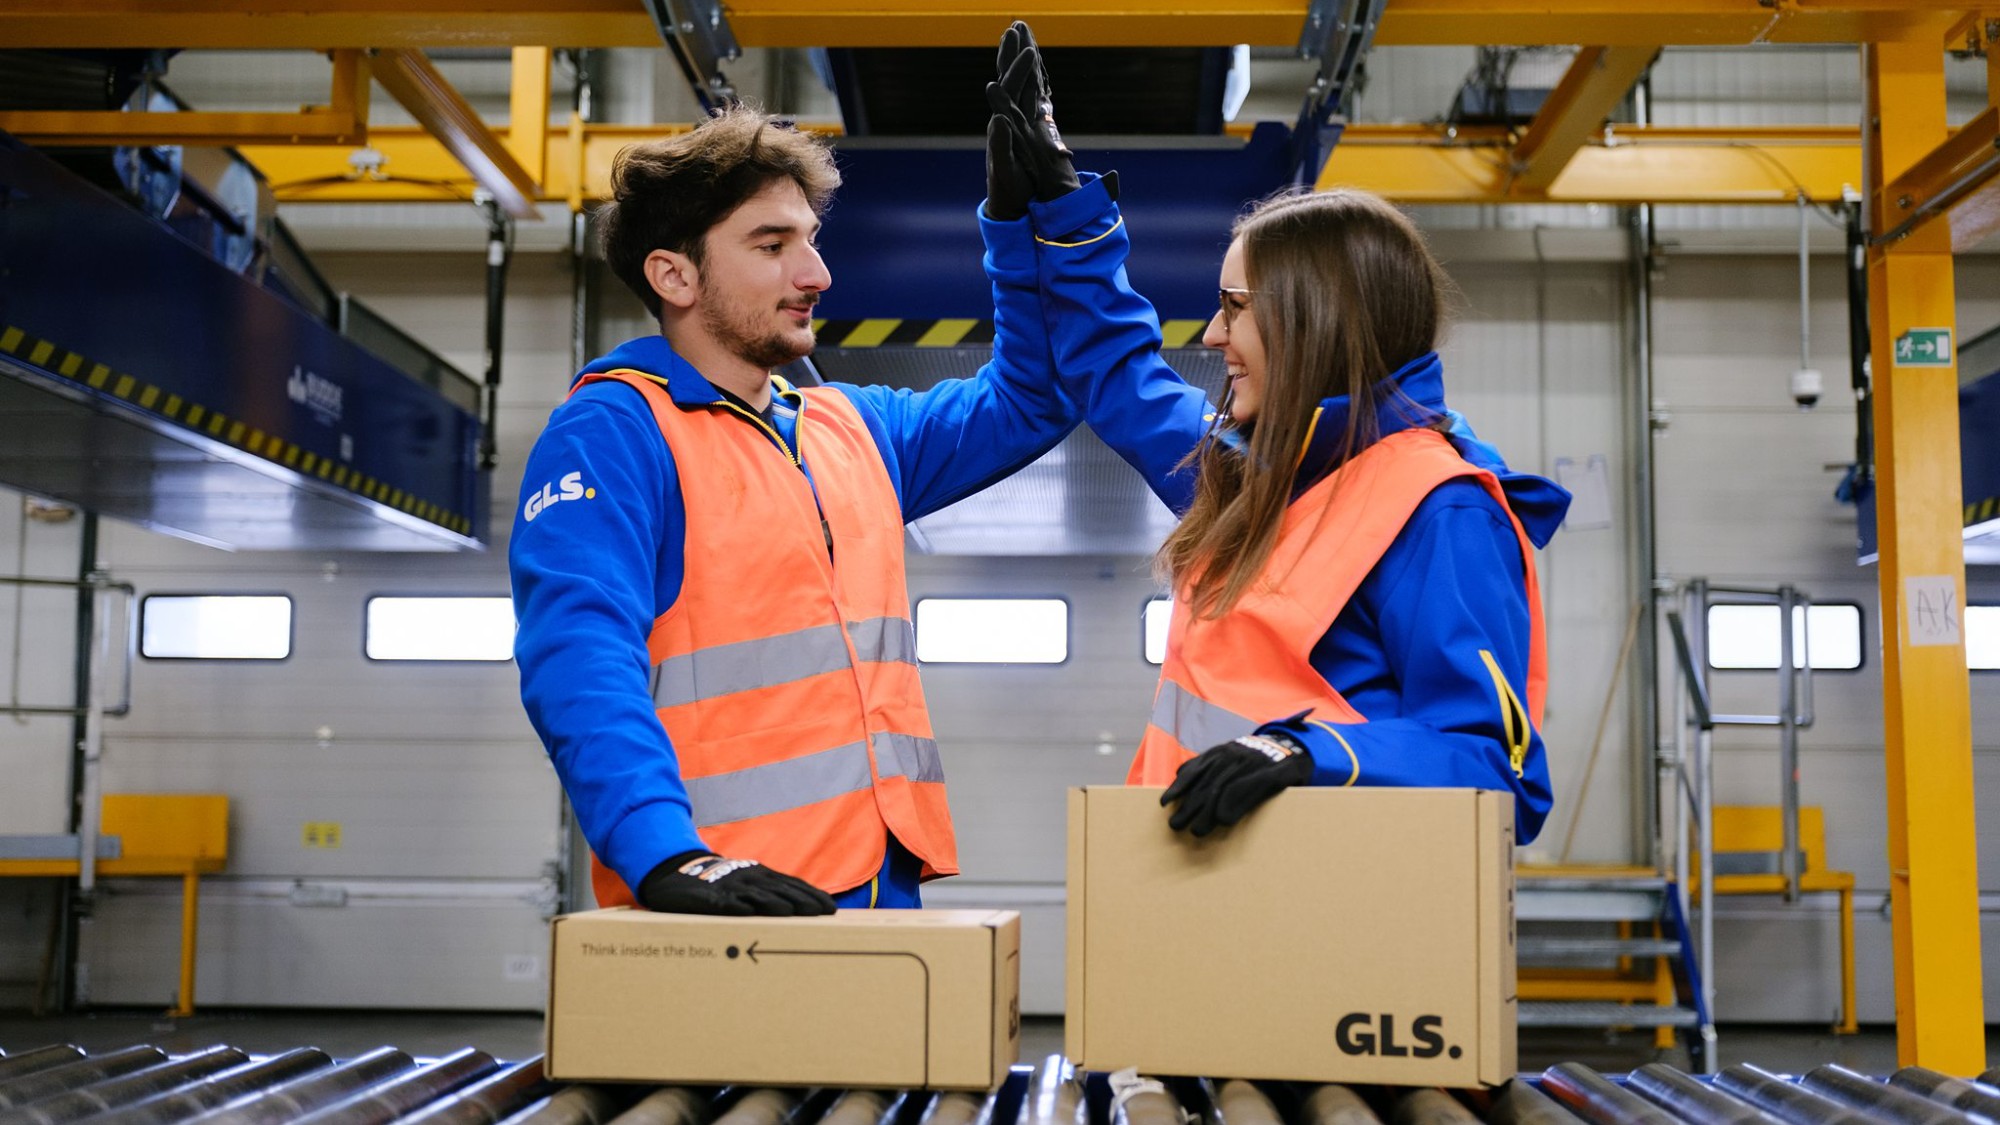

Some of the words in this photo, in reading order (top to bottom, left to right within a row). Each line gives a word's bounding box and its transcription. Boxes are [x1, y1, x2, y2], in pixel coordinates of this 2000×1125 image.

[524, 471, 596, 522] GLS.
[581, 943, 617, 956] Think
[621, 943, 660, 957] inside
[662, 944, 685, 957] the
[688, 944, 717, 958] box.
[1335, 1012, 1463, 1059] GLS.
